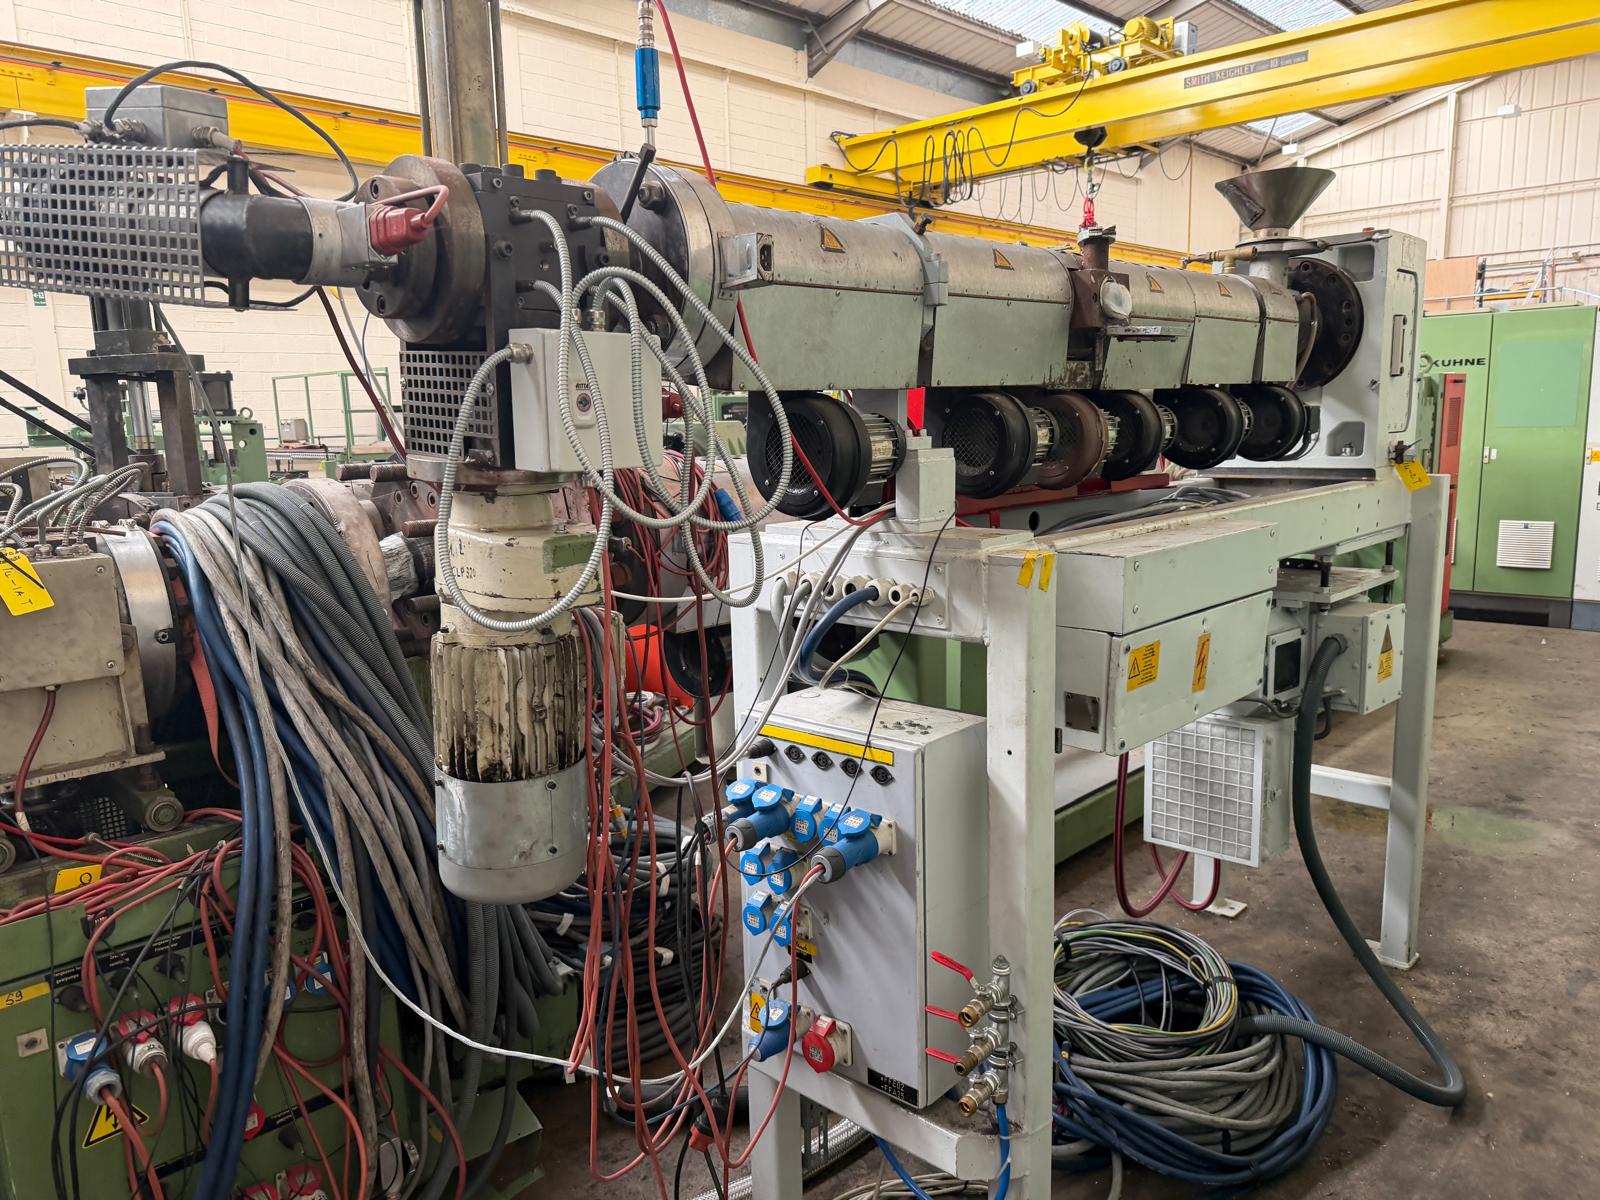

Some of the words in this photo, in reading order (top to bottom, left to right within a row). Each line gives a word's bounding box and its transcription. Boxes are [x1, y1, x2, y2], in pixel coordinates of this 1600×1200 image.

[1185, 75, 1211, 88] SMITH
[1215, 64, 1256, 81] KEIGHLEY
[1431, 357, 1487, 368] KUHNE
[575, 382, 590, 390] RITTA
